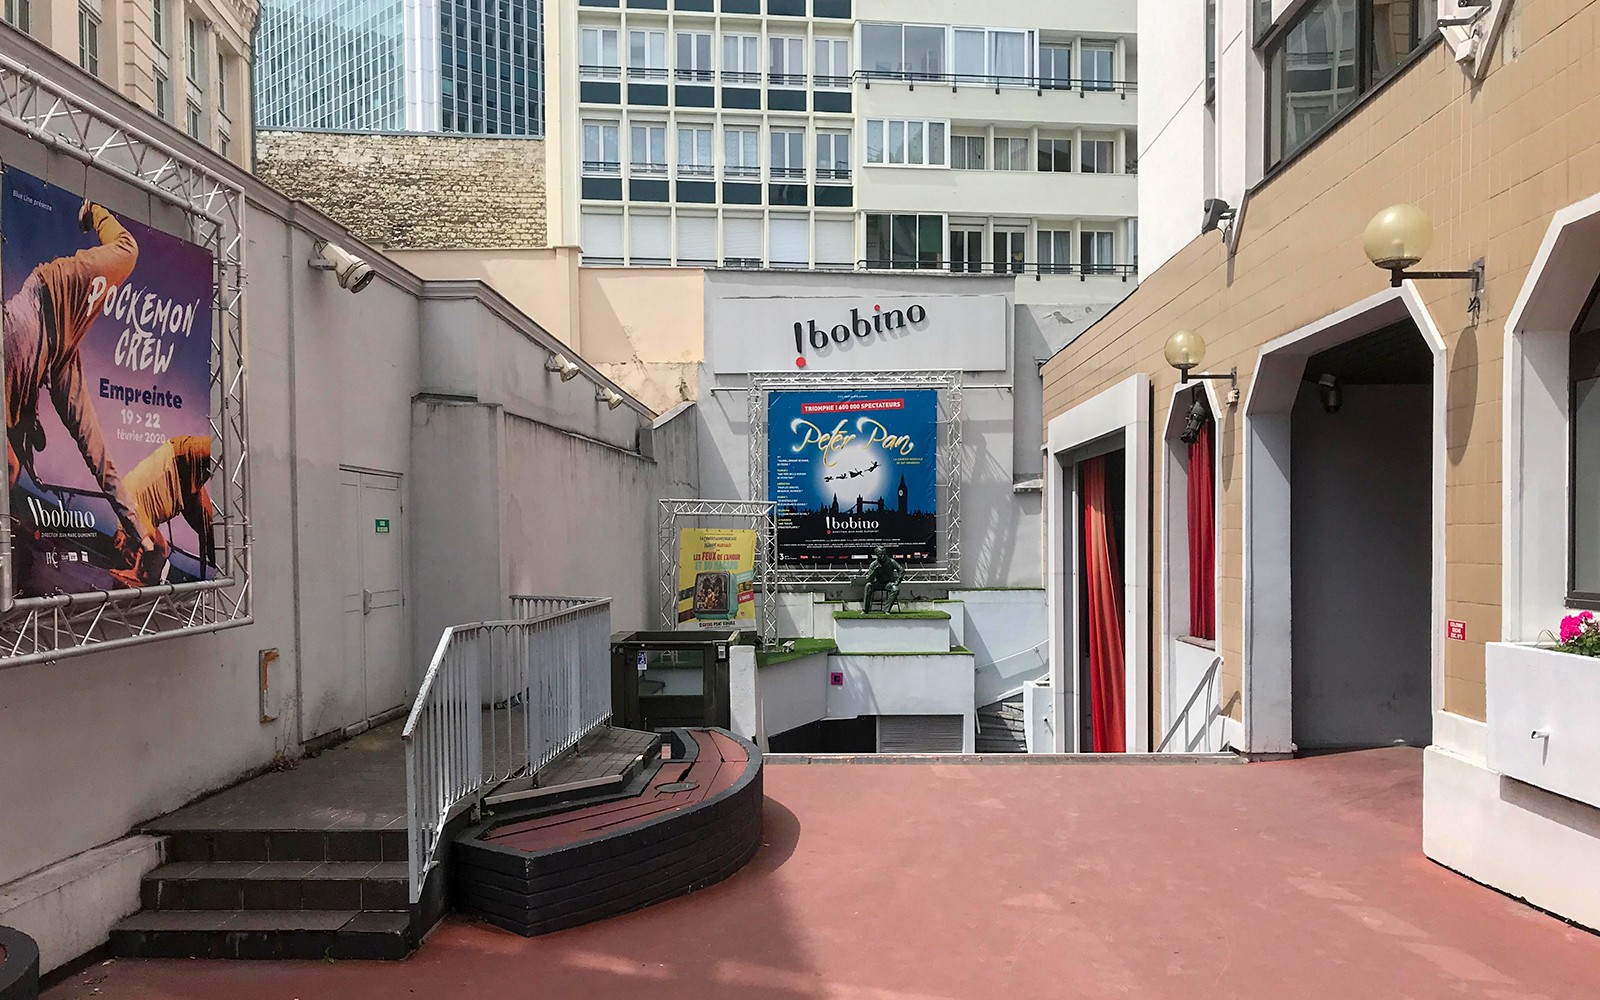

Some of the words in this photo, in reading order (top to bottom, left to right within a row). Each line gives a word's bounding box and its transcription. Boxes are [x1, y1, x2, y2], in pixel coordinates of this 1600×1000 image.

[12, 190, 23, 199] Blue
[33, 199, 52, 212] présente
[86, 276, 199, 337] POCKEMON
[114, 331, 176, 374] CREW
[99, 377, 182, 409] Empreinte
[860, 401, 901, 410] SPECTATEURS
[120, 409, 133, 427] 19
[144, 412, 161, 429] 22
[116, 427, 142, 444] février
[144, 431, 167, 445] 2020
[790, 417, 856, 468] Peter
[856, 416, 915, 456] Pan
[693, 553, 701, 561] LES
[702, 551, 716, 561] FEUX
